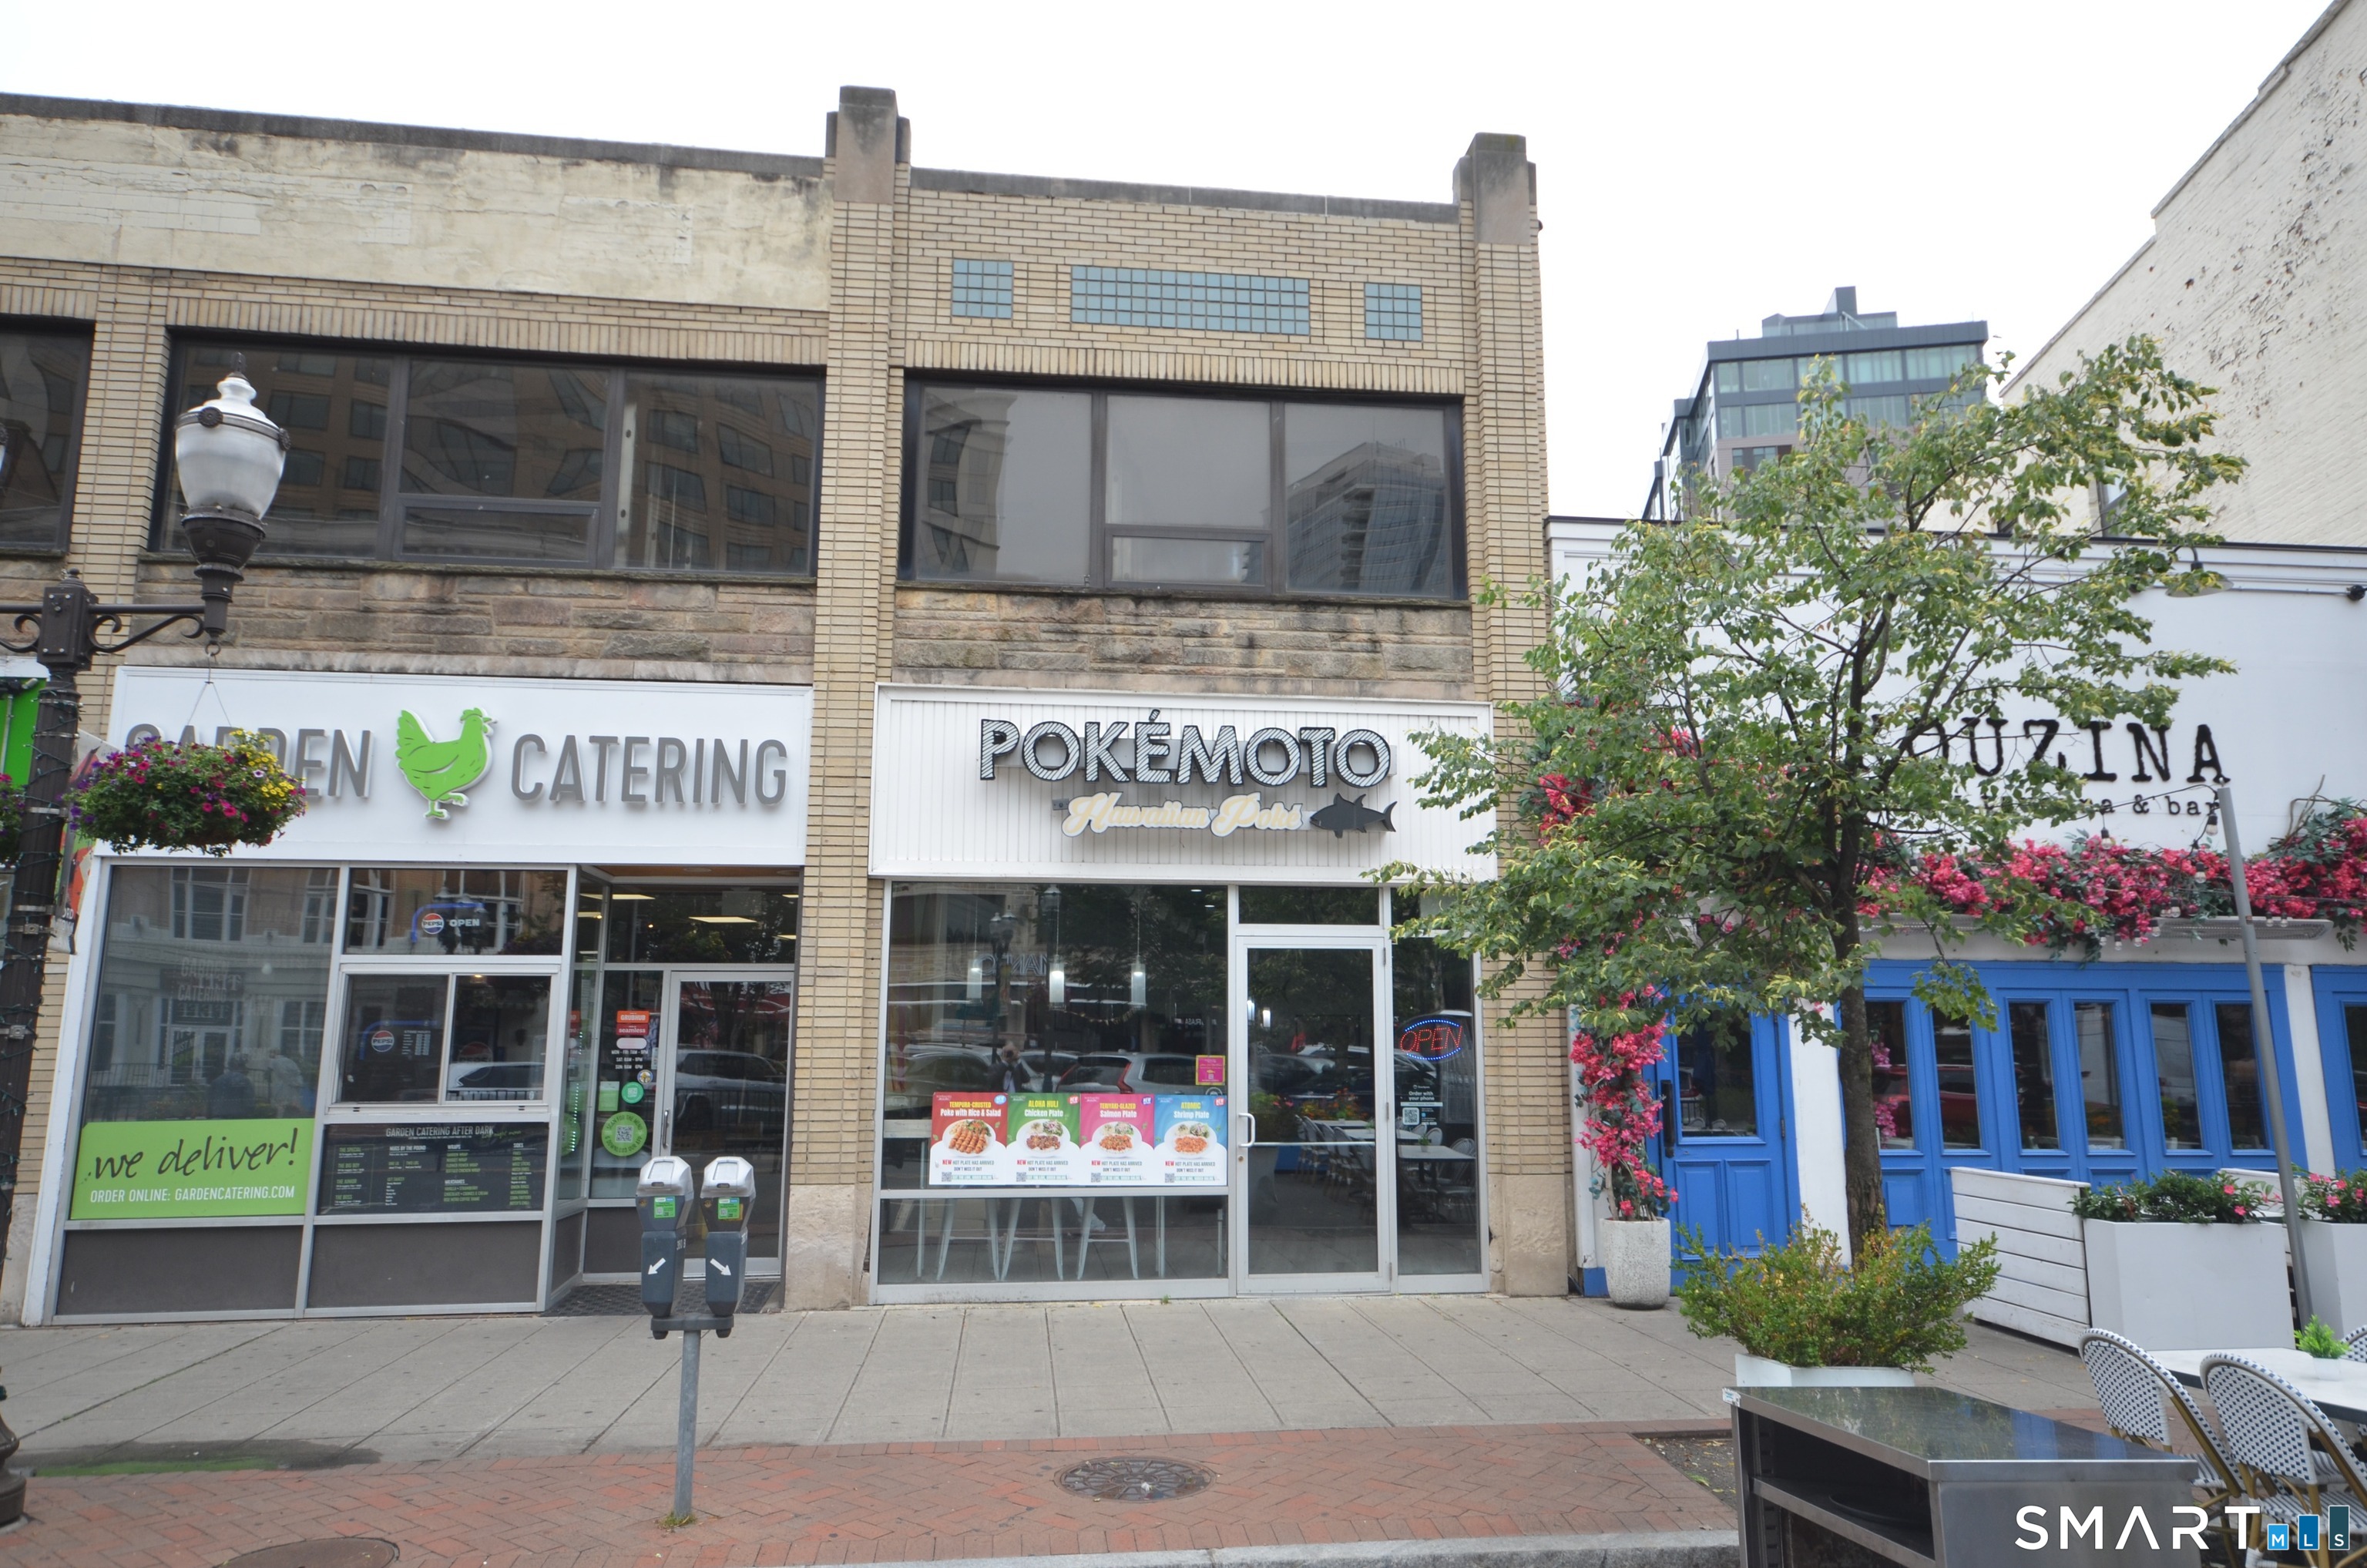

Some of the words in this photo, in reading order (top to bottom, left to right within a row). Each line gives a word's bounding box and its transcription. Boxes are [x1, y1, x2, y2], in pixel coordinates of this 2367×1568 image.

[980, 709, 1391, 787] POKÉMOTO
[1858, 713, 2231, 784] OUZINA
[511, 734, 787, 805] CATERING
[1062, 791, 1211, 838] Hawaiian
[2133, 794, 2150, 814] &
[449, 918, 480, 927] OPEN
[178, 984, 227, 1002] CATERING
[1400, 1026, 1462, 1053] OPEN
[386, 1127, 415, 1137] GARDEN
[416, 1126, 451, 1136] CATERING
[452, 1126, 474, 1135] AFTER
[475, 1125, 494, 1135] DARK
[96, 1152, 143, 1179] we
[157, 1127, 298, 1177] deliver!
[90, 1190, 125, 1203] ORDER
[129, 1188, 171, 1202] ONLINE:
[175, 1186, 295, 1201] GARDENCATERING.COM
